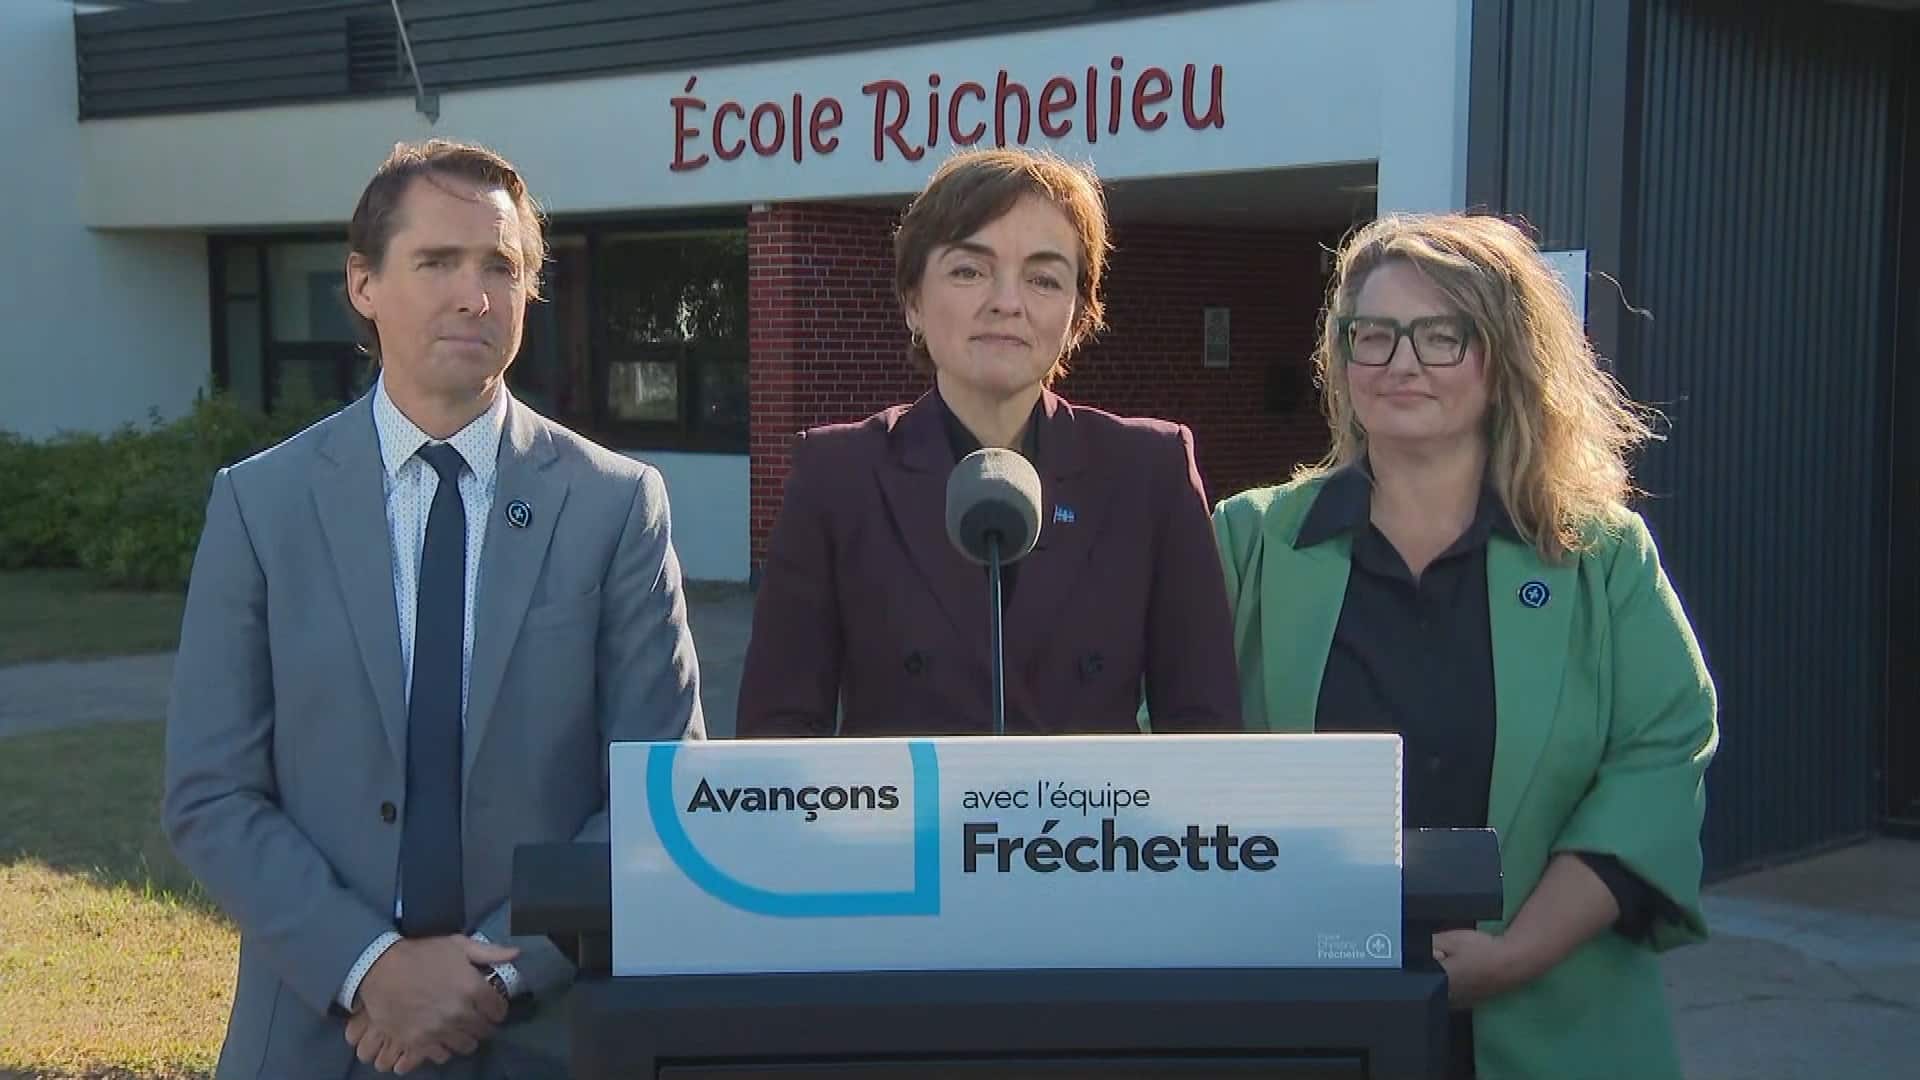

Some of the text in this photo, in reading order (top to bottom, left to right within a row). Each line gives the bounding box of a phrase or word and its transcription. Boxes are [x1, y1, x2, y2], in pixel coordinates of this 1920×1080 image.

[669, 56, 1225, 172] École Richelieu
[686, 777, 900, 822] Avançons
[962, 780, 1150, 816] avec l'équipe
[963, 818, 1280, 873] Fréchette
